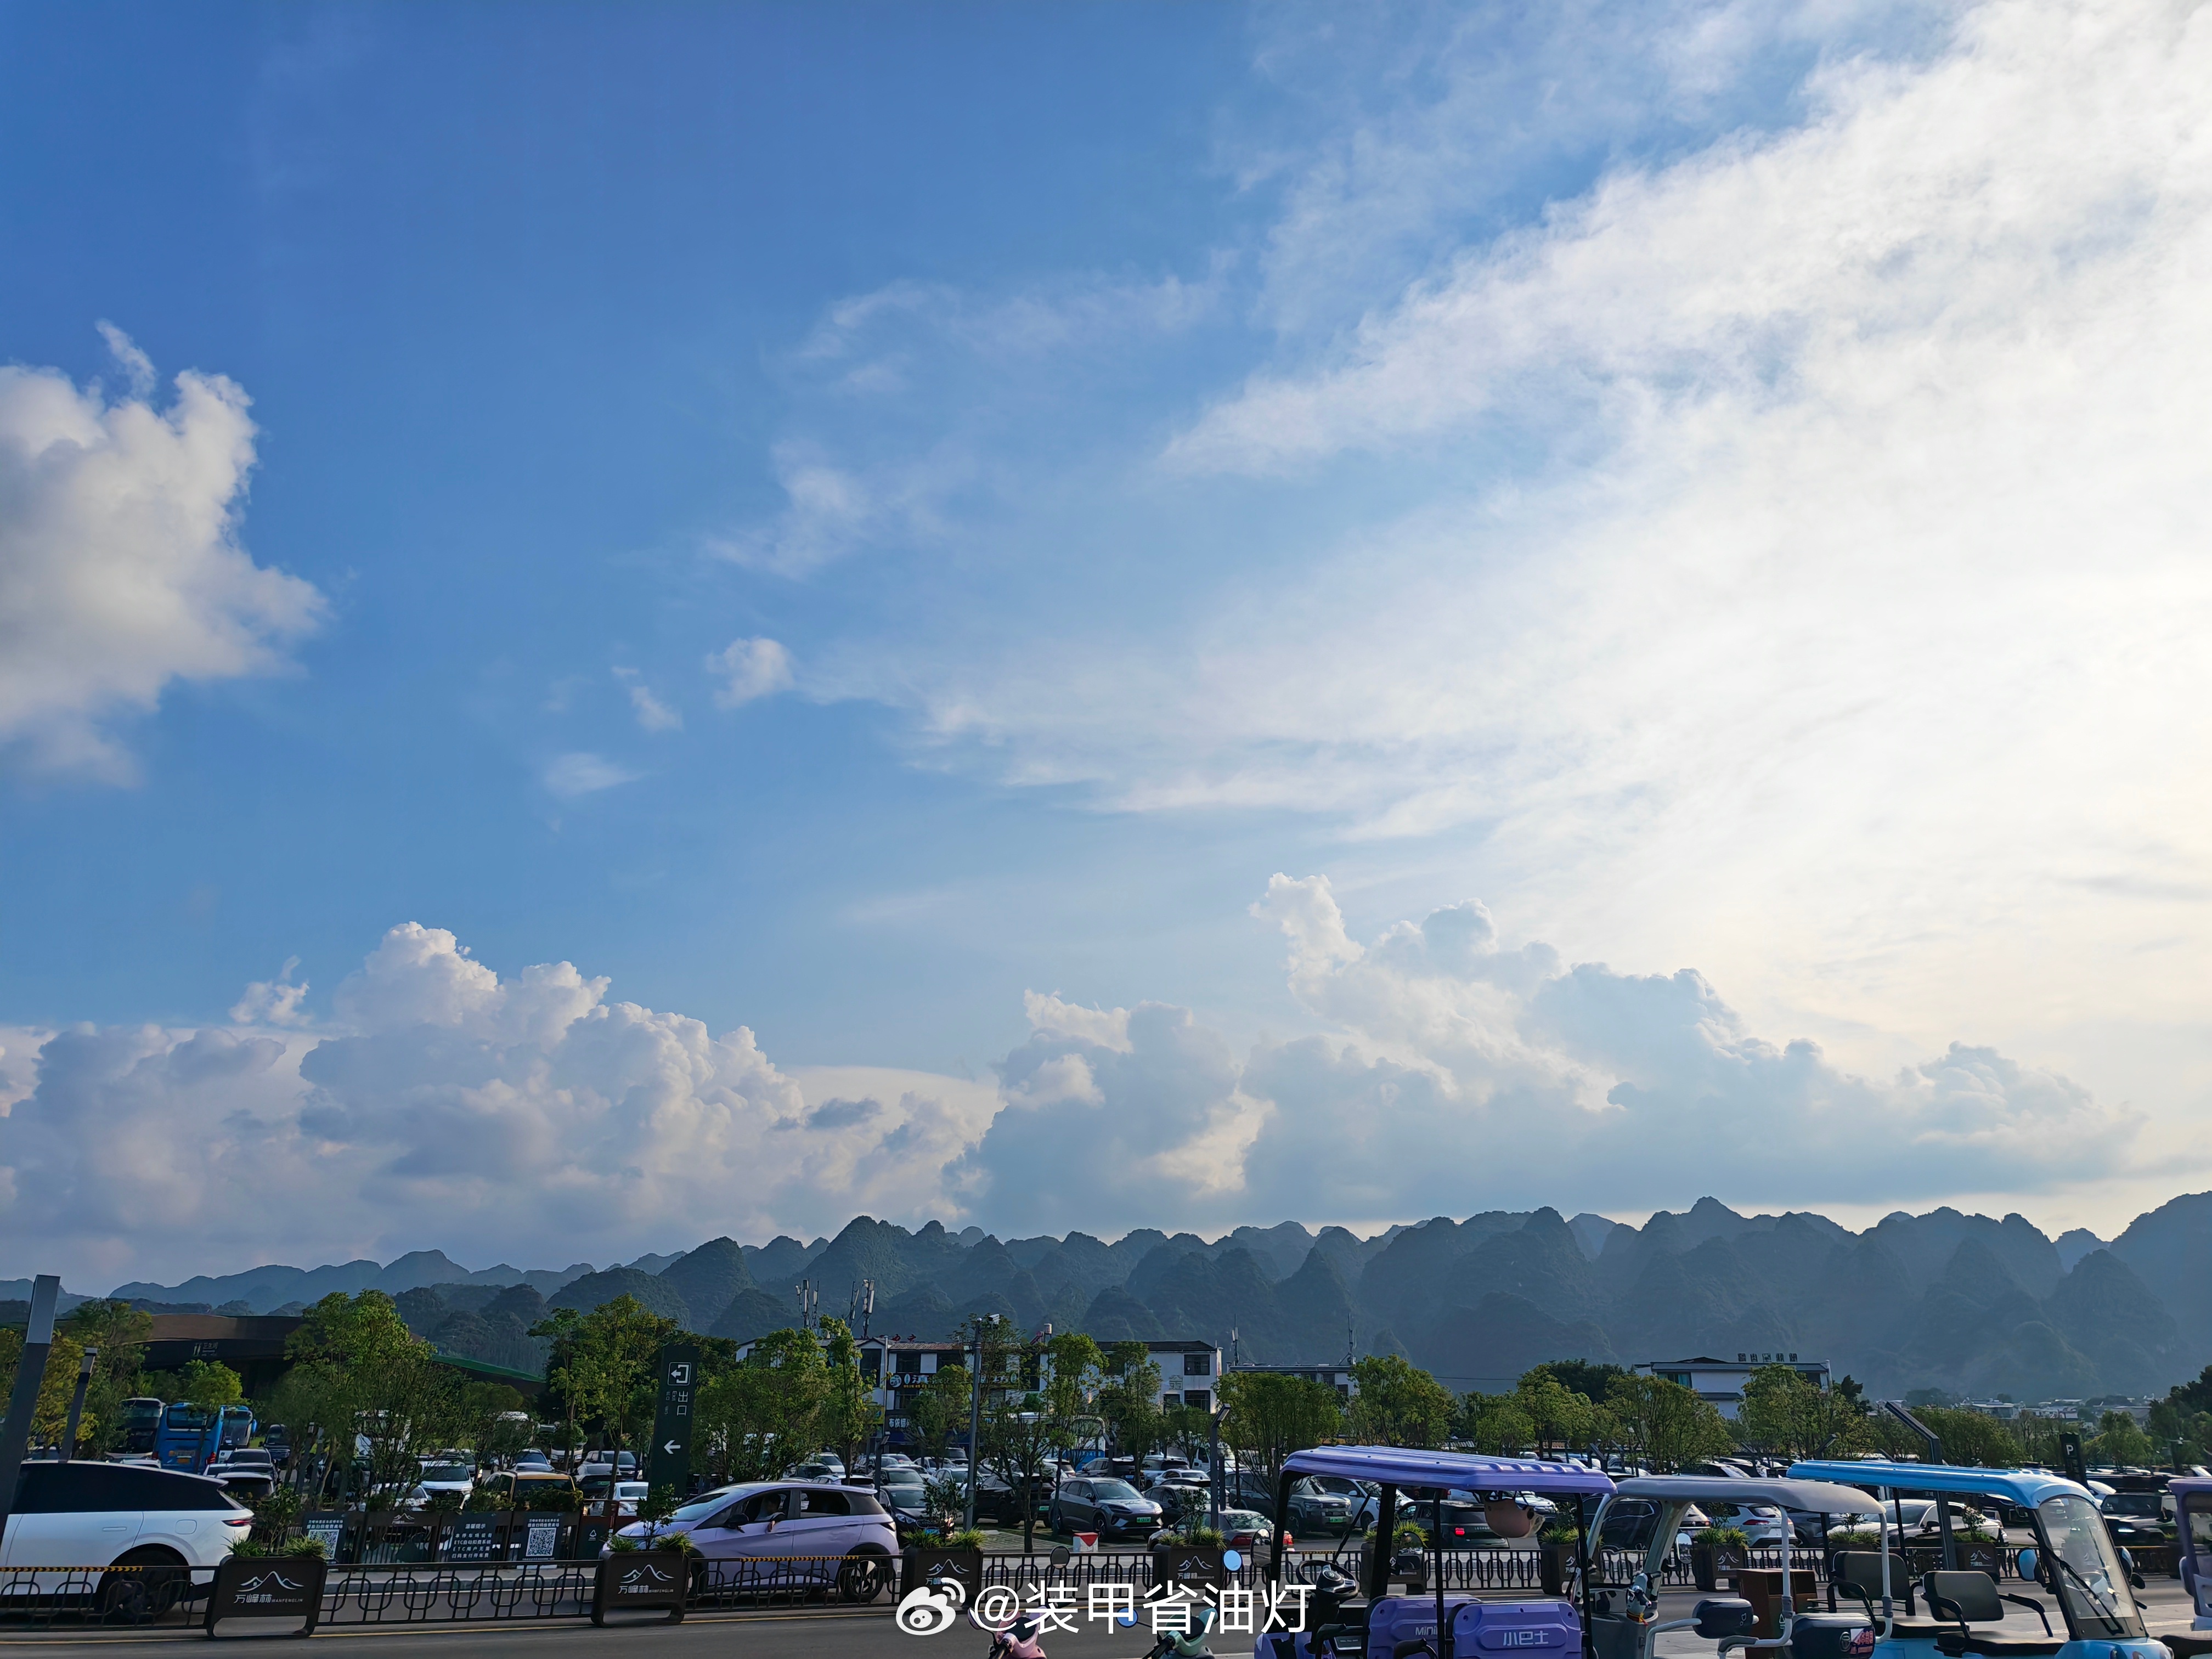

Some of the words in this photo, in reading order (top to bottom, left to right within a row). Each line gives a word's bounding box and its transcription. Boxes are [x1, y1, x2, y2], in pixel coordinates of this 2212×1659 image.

[676, 1390, 689, 1416] 出口
[2066, 1444, 2074, 1455] P
[618, 1584, 649, 1594] 万峰林
[233, 1594, 273, 1604] 万峰林
[1503, 1630, 1549, 1646] 小巴士
